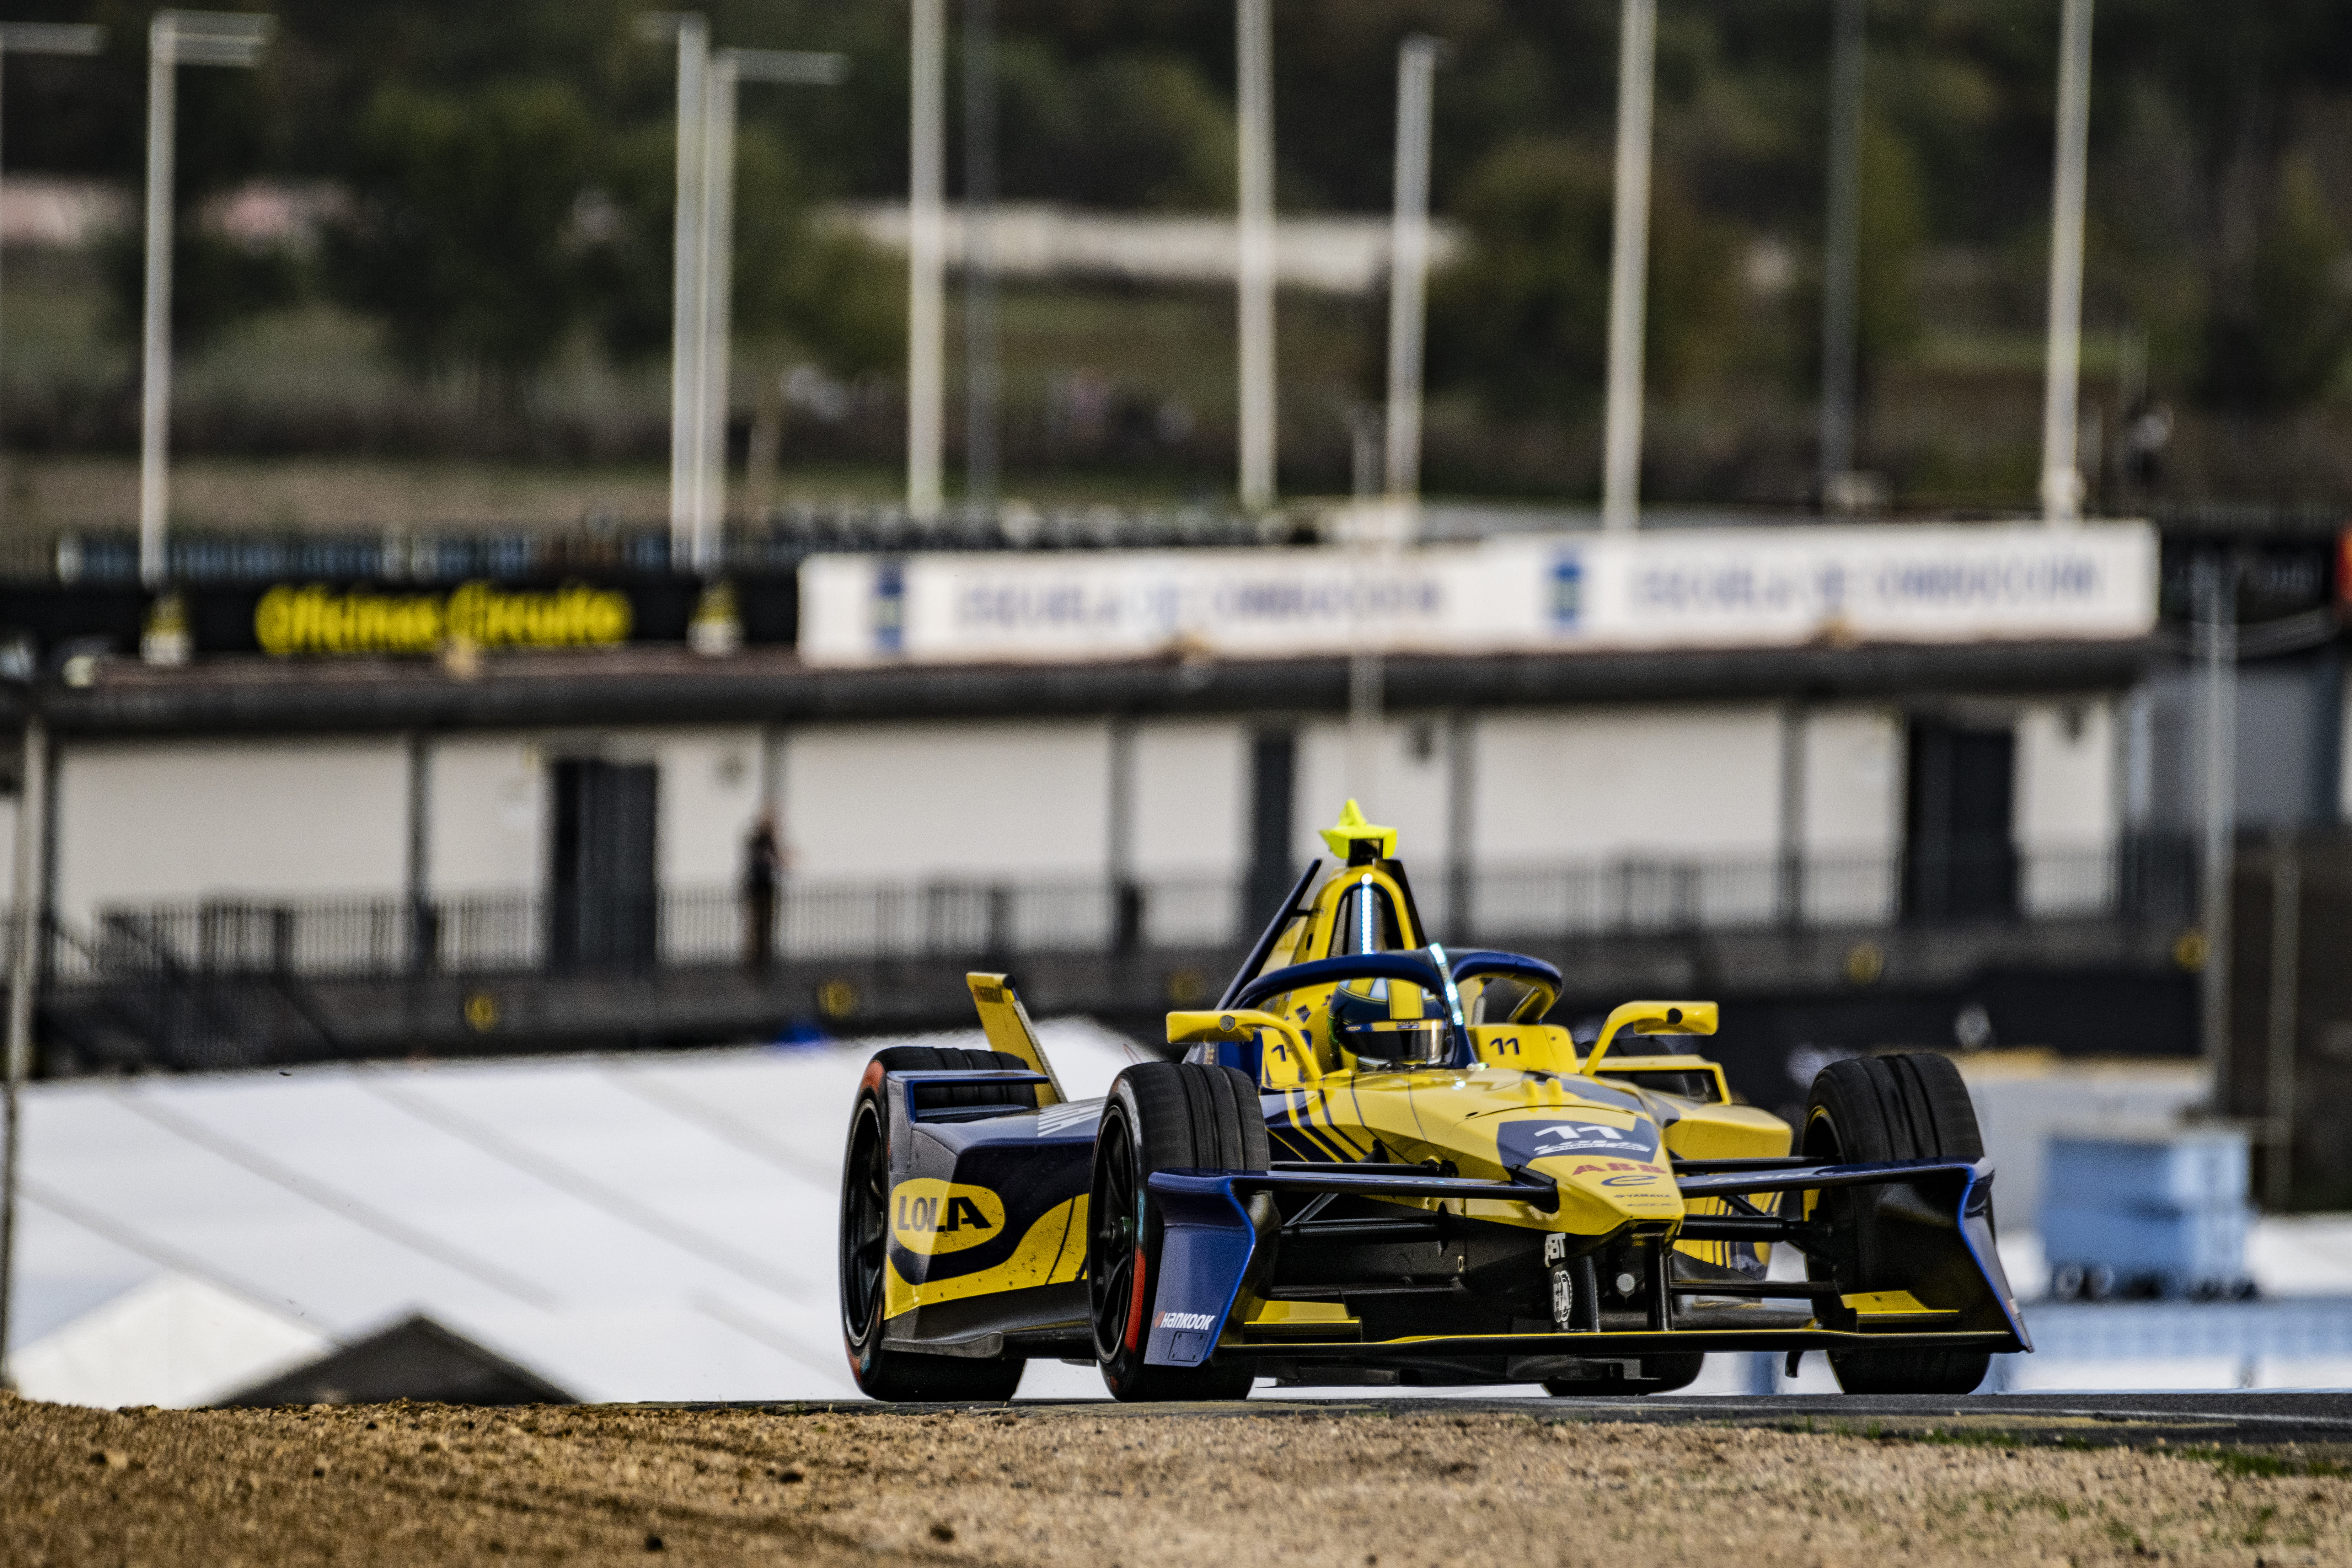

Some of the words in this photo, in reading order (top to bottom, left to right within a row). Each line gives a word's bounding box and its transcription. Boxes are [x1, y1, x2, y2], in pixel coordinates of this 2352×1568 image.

[1489, 1037, 1520, 1056] 11
[1534, 1125, 1622, 1139] 11
[1573, 1163, 1666, 1176] ABB
[897, 1195, 992, 1232] LOLA
